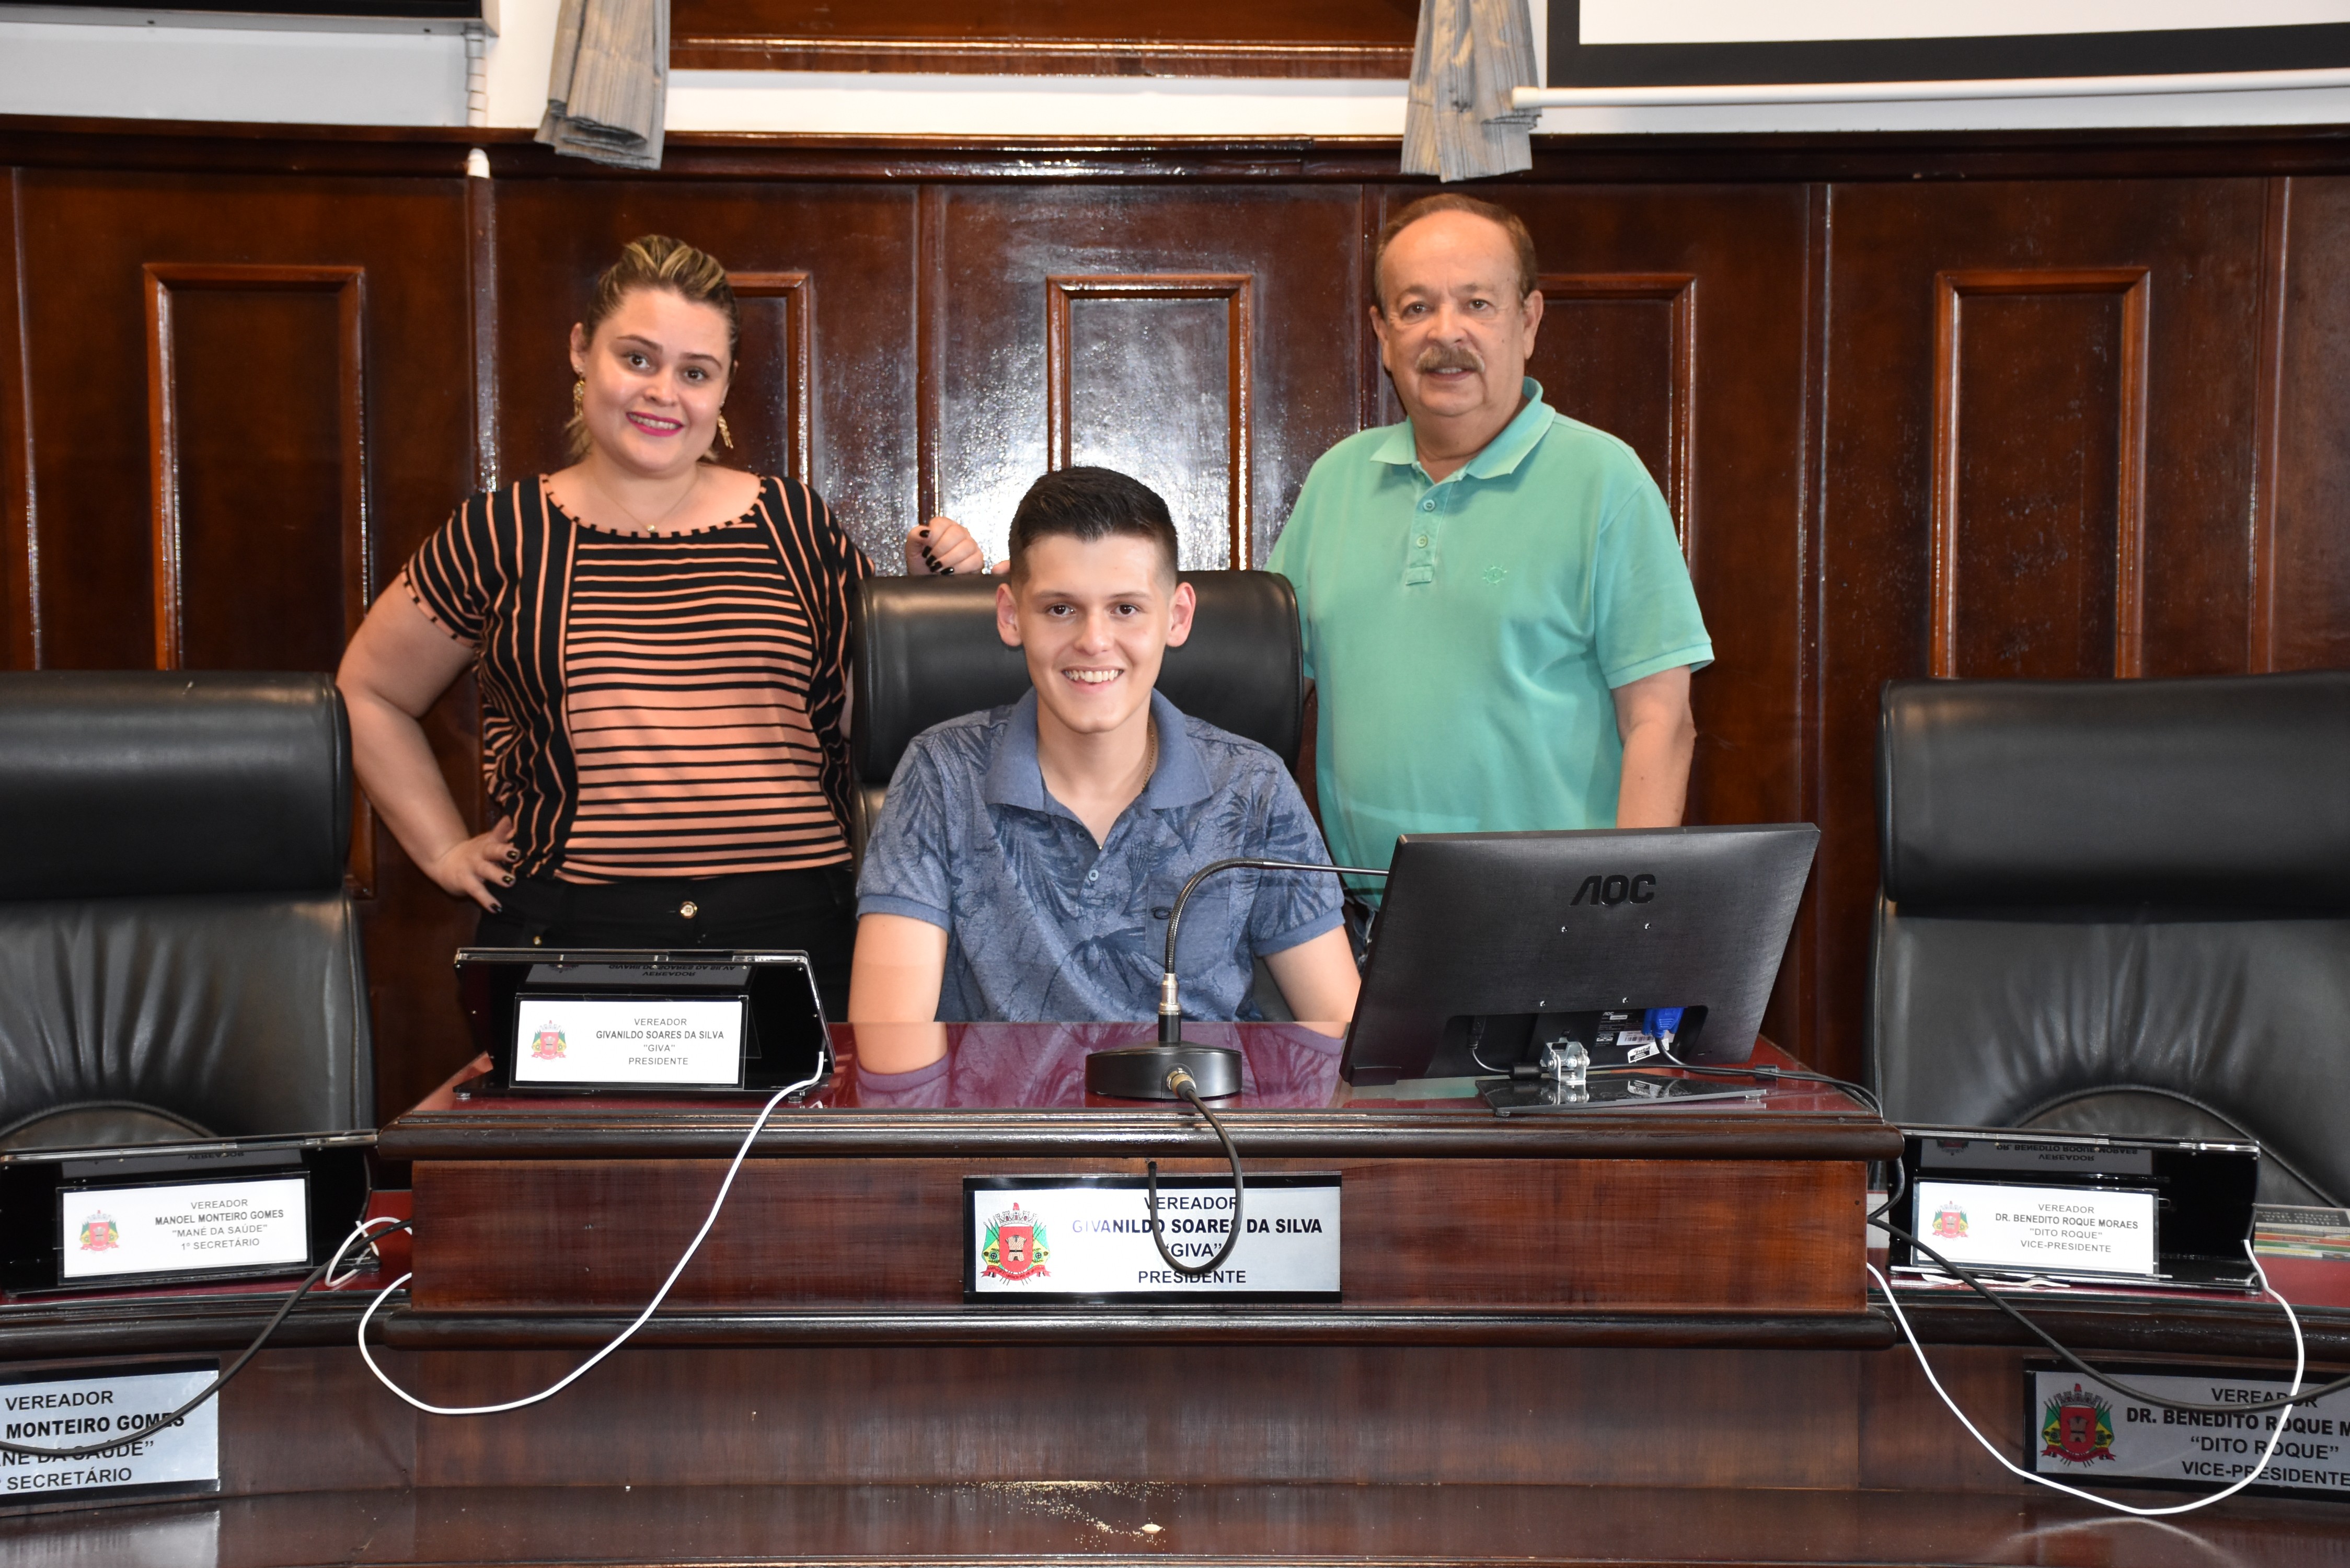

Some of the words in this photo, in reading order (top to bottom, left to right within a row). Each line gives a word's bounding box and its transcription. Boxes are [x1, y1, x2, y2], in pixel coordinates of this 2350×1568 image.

[1570, 874, 1656, 906] AOC
[596, 1031, 643, 1039] GIVANILDO
[646, 1031, 682, 1039] SOARES
[684, 1031, 696, 1039] DA
[699, 1031, 724, 1039] SILVA
[191, 1199, 248, 1209] VEREADOR
[2038, 1204, 2094, 1214] VEREADOR
[155, 1215, 195, 1225] MANOEL
[198, 1212, 247, 1223] MONTEIRO
[250, 1209, 284, 1219] GOMES
[1996, 1213, 2010, 1221] DR.
[2013, 1214, 2059, 1224] BENEDITO
[2063, 1217, 2095, 1226] ROQUE
[2099, 1219, 2138, 1229] MORAES
[172, 1226, 207, 1237] "MANÉ
[210, 1227, 225, 1236] DA
[227, 1224, 268, 1235] SAÚDE"
[1171, 1219, 1235, 1233] SOARE
[1247, 1218, 1270, 1233] DA
[1275, 1218, 1322, 1233] SILVA
[2030, 1228, 2058, 1237] "DITO
[2061, 1230, 2102, 1239] ROQUE"
[193, 1238, 260, 1250] SECRETÁRIO
[2021, 1240, 2112, 1252] VICE-PRESIDENTE
[1138, 1271, 1246, 1283] PRESIDENTE
[5, 1390, 113, 1411] VEREADOR
[2211, 1388, 2318, 1408] VEREA
[6, 1416, 110, 1439] MONTEIRO
[2127, 1407, 2157, 1424] DR.
[2163, 1409, 2259, 1430] BENEDITO
[2265, 1415, 2333, 1435] ROQUE
[7, 1466, 132, 1491] SECRETÁRIO
[2182, 1461, 2350, 1486] VICE-PRESIDENTE
